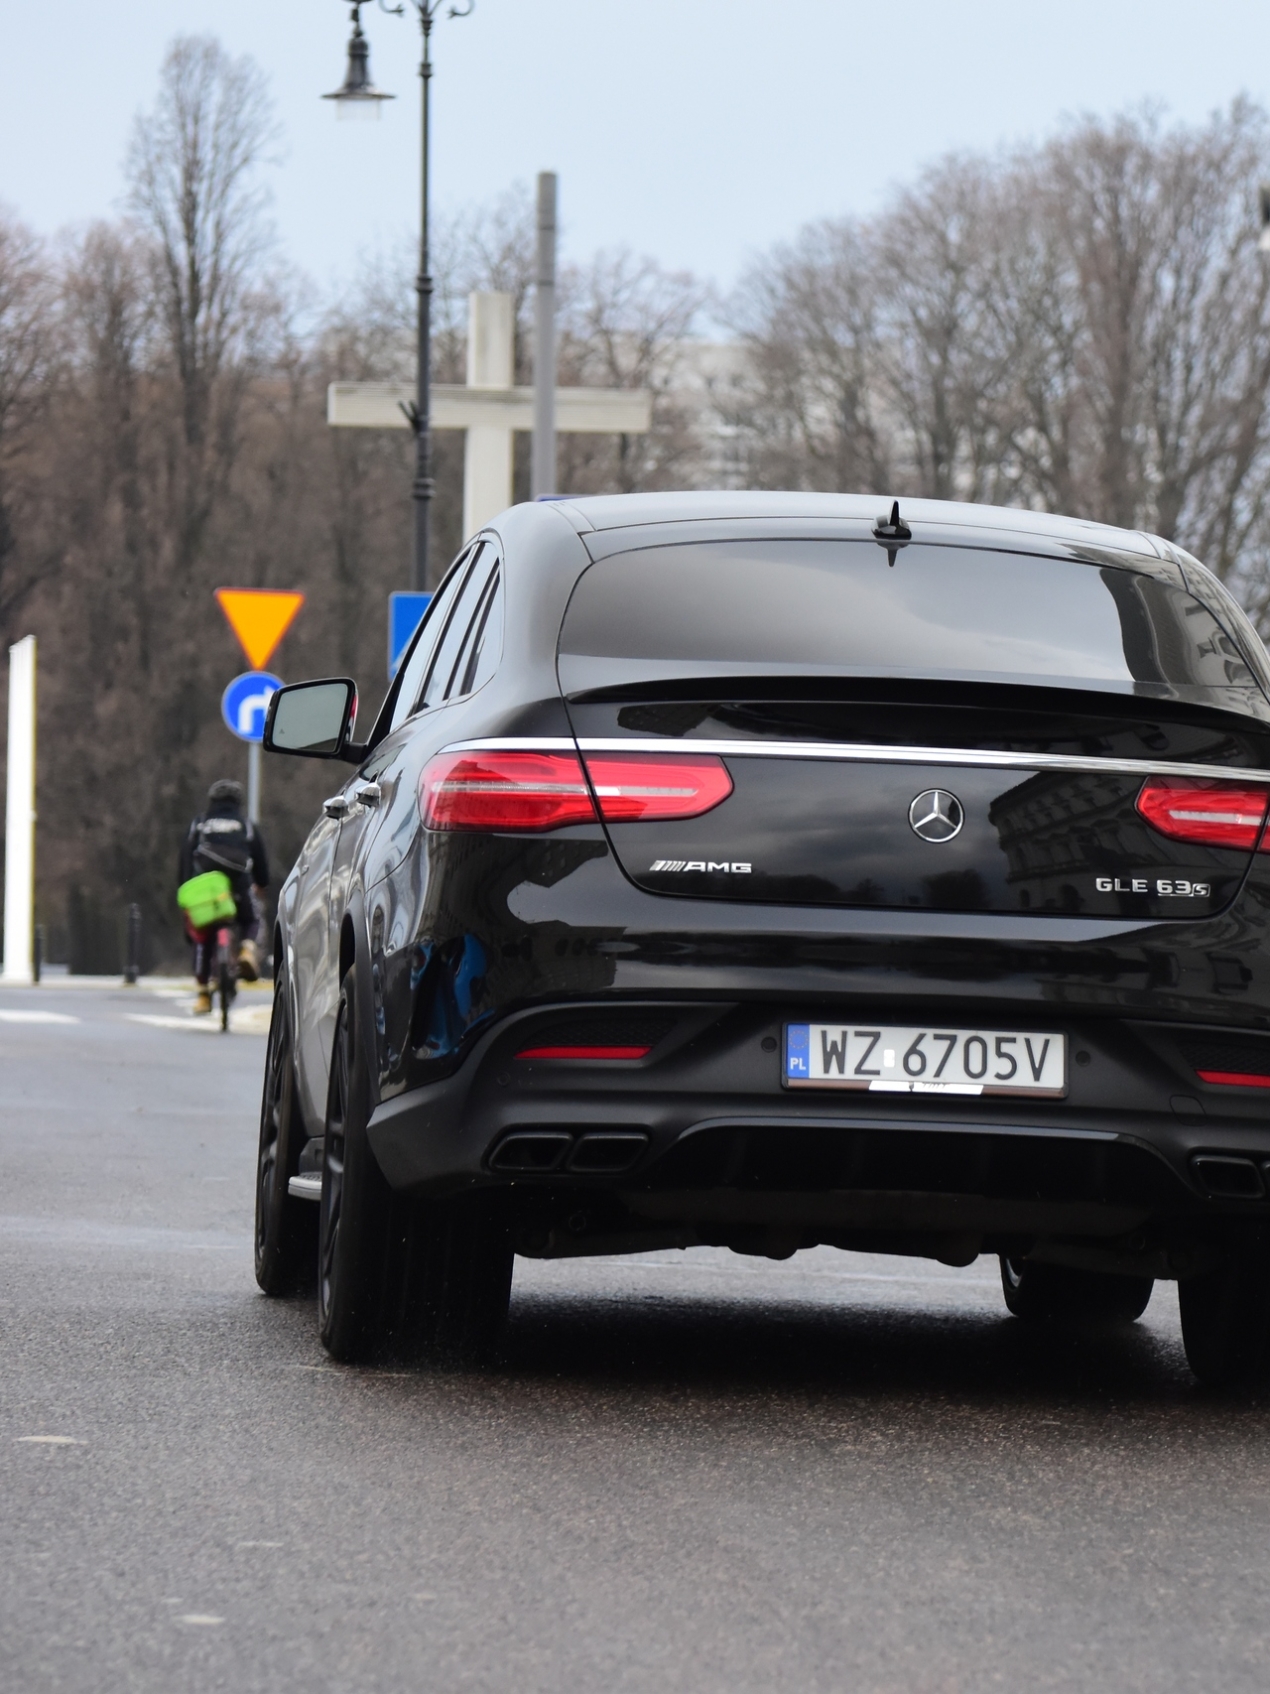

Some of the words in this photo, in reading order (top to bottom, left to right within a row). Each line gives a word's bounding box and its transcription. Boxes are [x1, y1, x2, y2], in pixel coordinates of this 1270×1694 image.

[682, 861, 752, 874] AMG
[1096, 878, 1148, 893] GLE
[789, 1057, 807, 1071] PL
[820, 1030, 882, 1076] WZ
[902, 1033, 1051, 1082] 6705V
